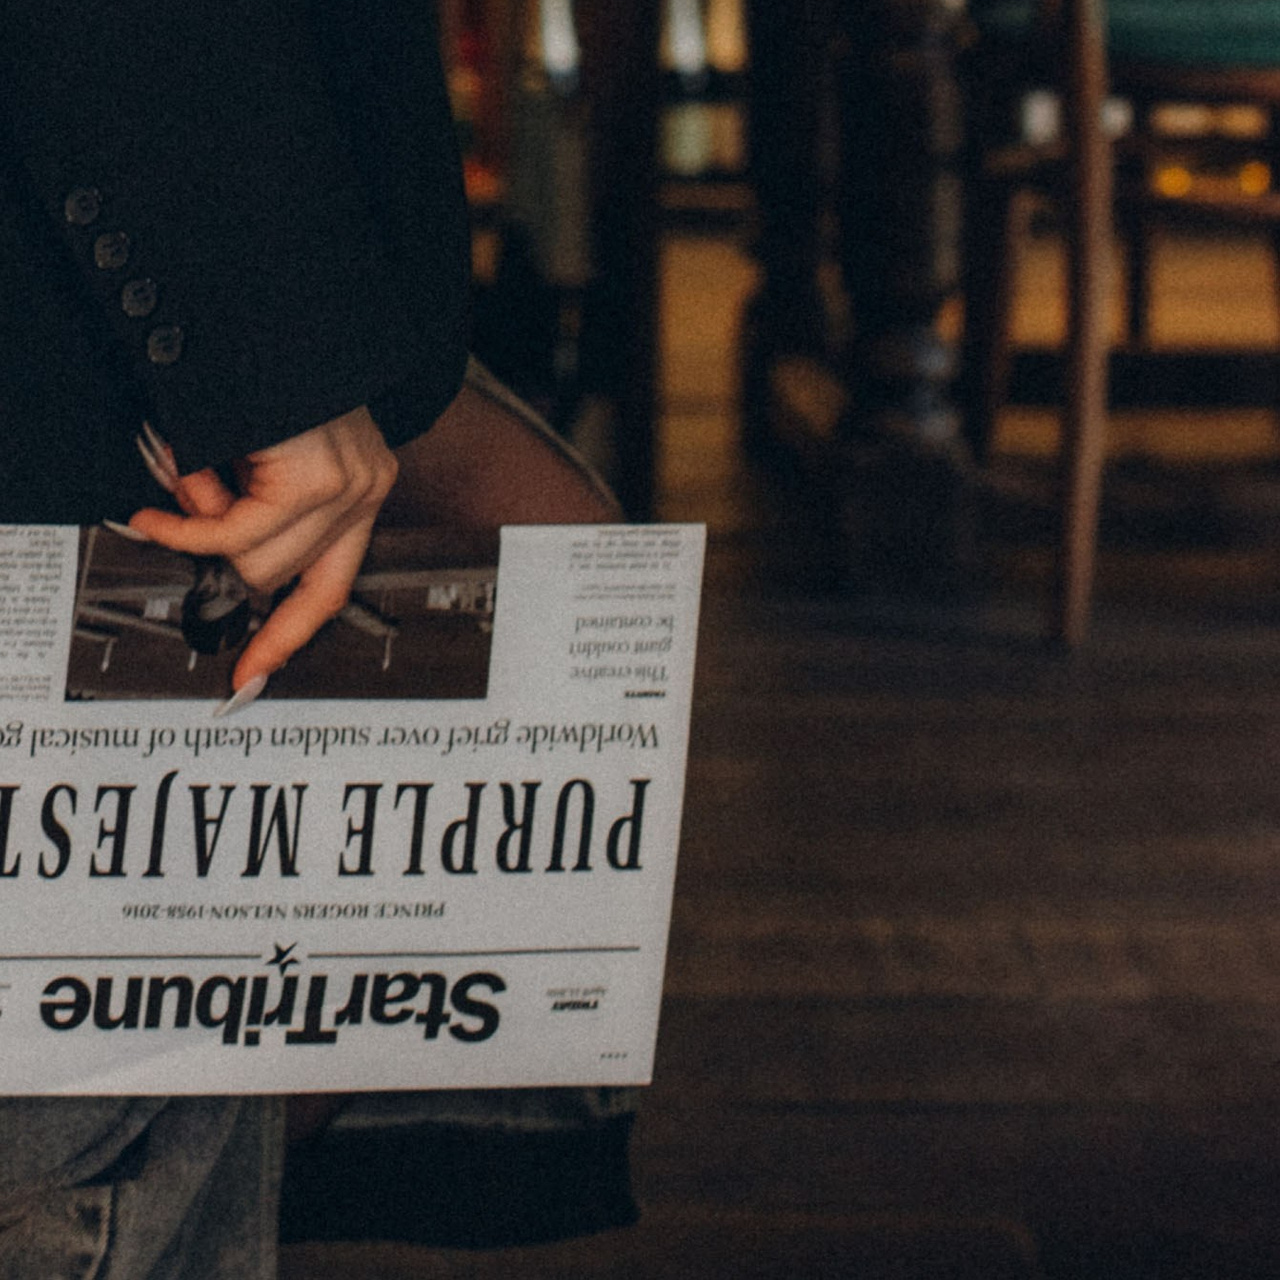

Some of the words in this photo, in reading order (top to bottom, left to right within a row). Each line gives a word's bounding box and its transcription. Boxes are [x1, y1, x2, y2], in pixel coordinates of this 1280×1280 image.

[575, 616, 653, 634] contained
[657, 615, 674, 634] be
[633, 636, 672, 655] giant
[570, 666, 633, 681] creative
[635, 666, 669, 682] This
[29, 727, 140, 757] musical
[142, 727, 176, 758] of
[183, 726, 263, 758] death
[269, 726, 372, 756] sudden
[376, 726, 439, 747] over
[441, 719, 511, 756] grief
[515, 723, 659, 754] Worldwide
[337, 777, 651, 877] PURPLE
[292, 903, 370, 919] ROGERS
[374, 901, 446, 919] PRINCE
[39, 972, 507, 1047] StarTribune
